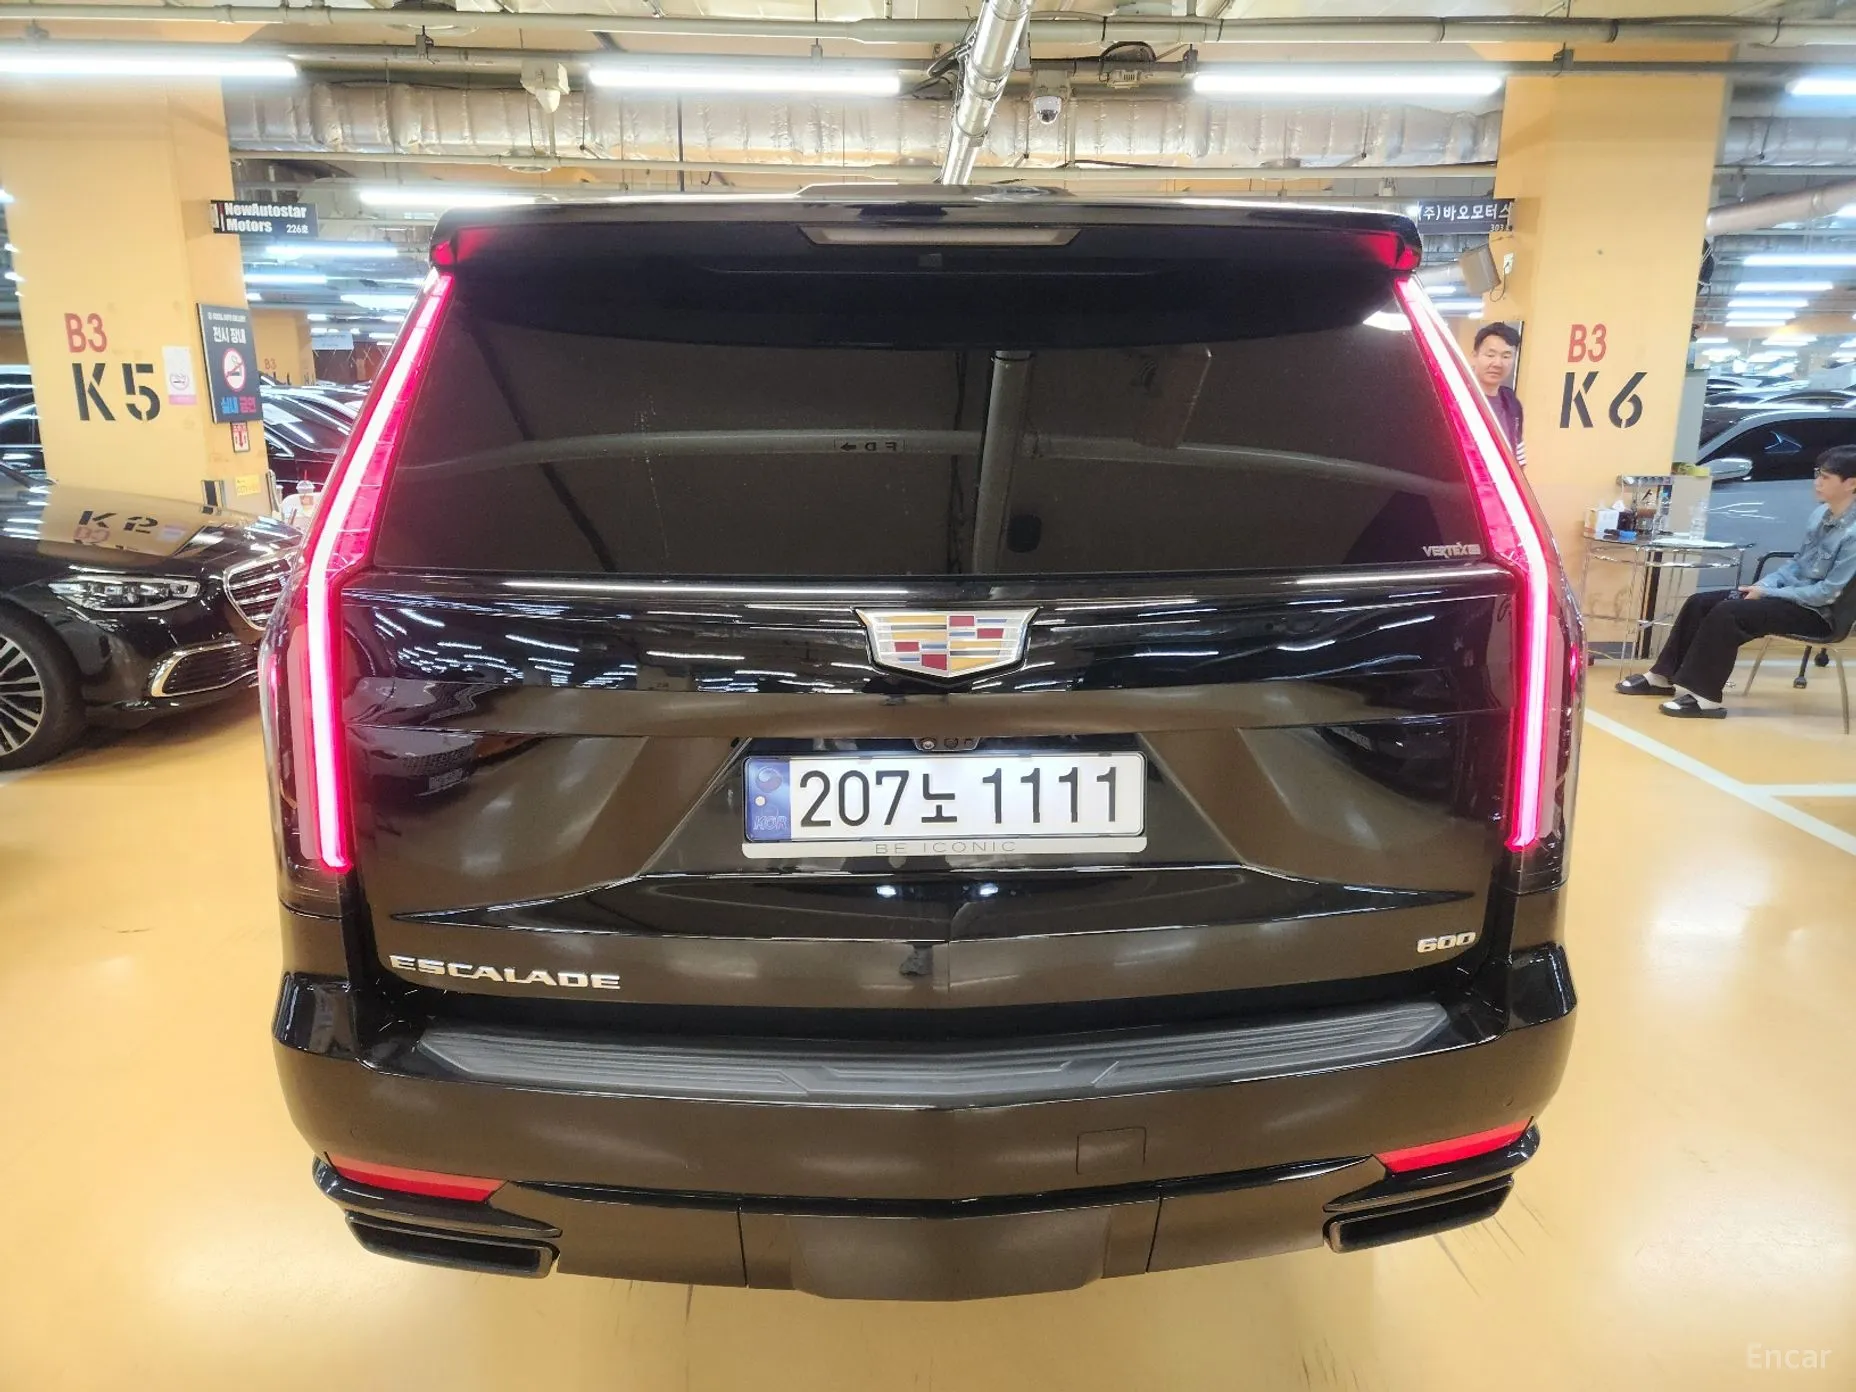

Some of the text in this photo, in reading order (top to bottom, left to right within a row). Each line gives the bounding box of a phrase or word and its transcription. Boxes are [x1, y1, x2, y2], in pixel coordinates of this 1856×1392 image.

[224, 202, 307, 218] NewAutostar
[226, 218, 273, 232] Motors
[64, 313, 107, 353] B3
[1567, 324, 1607, 363] B3
[72, 363, 161, 421] K5
[1560, 372, 1648, 429] K6
[799, 766, 1117, 827] 207노 1111
[875, 840, 1017, 855] BE ICONIC
[1417, 932, 1476, 953] 600
[389, 954, 621, 990] ESCALADE
